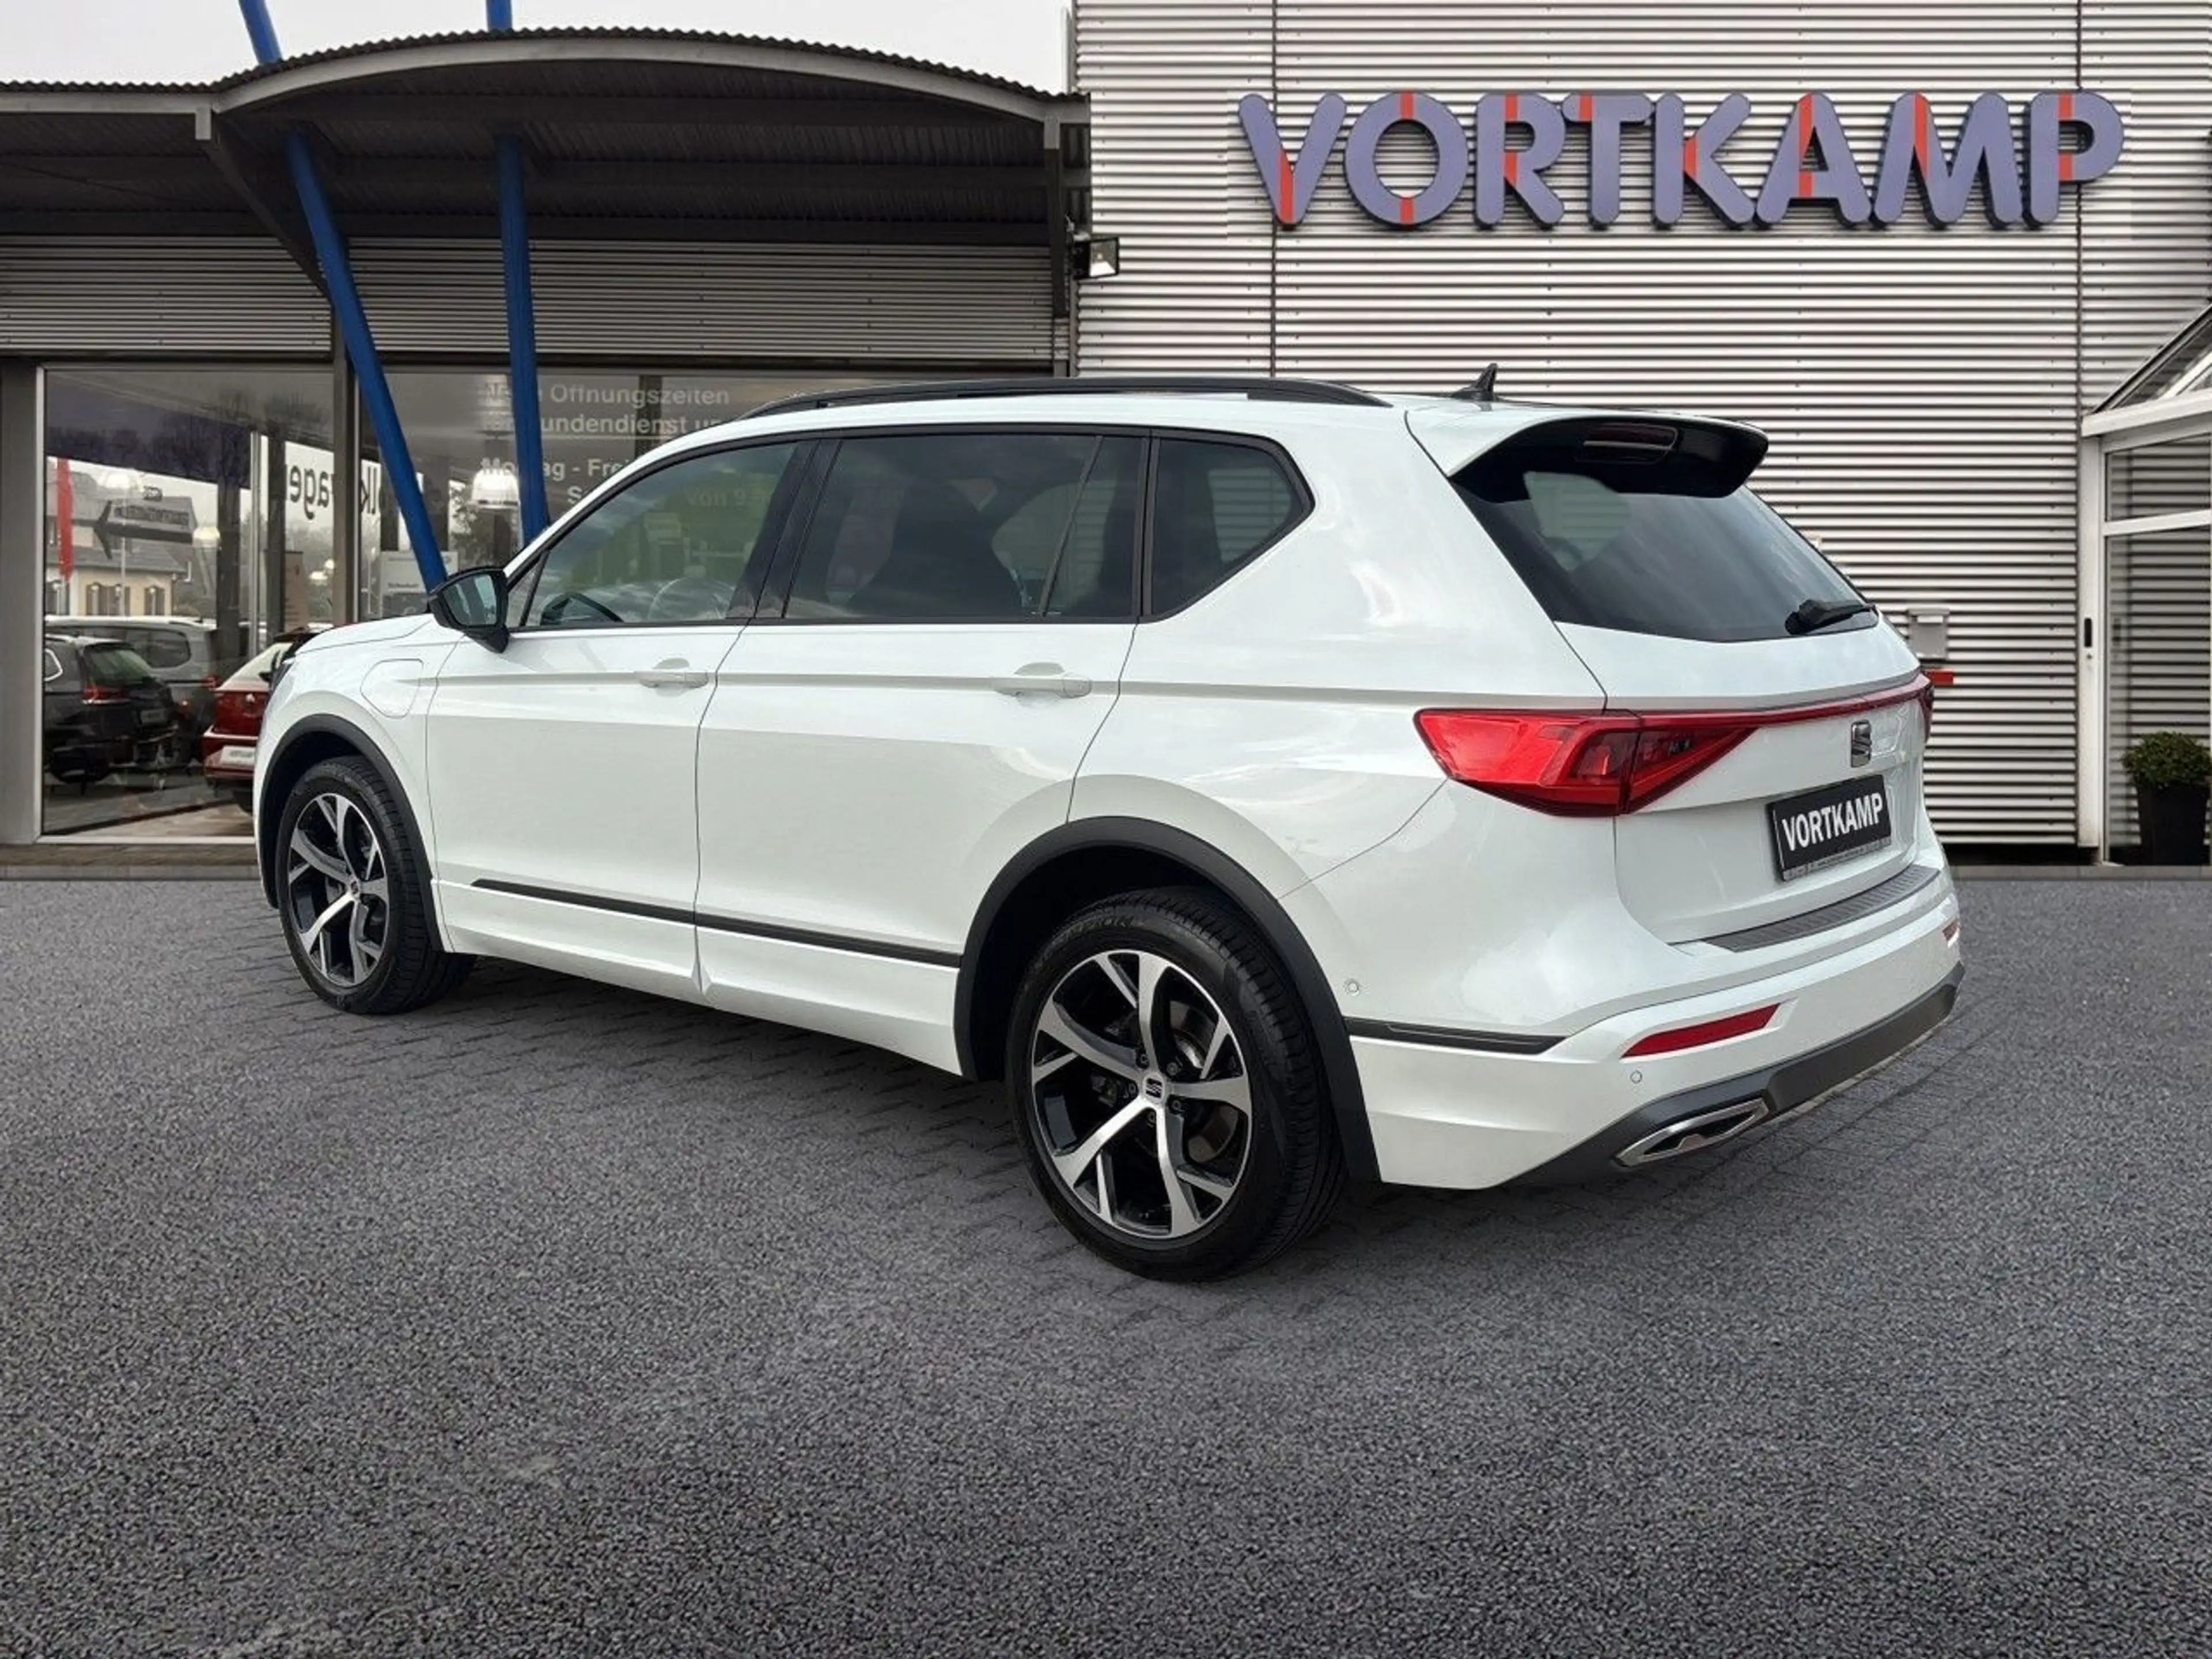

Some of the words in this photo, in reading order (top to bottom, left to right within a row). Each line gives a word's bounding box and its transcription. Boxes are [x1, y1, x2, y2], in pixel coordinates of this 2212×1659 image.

[1237, 90, 2124, 228] VORTKAMP
[539, 414, 687, 434] undendienst
[1782, 793, 1883, 851] VORTKAMP
